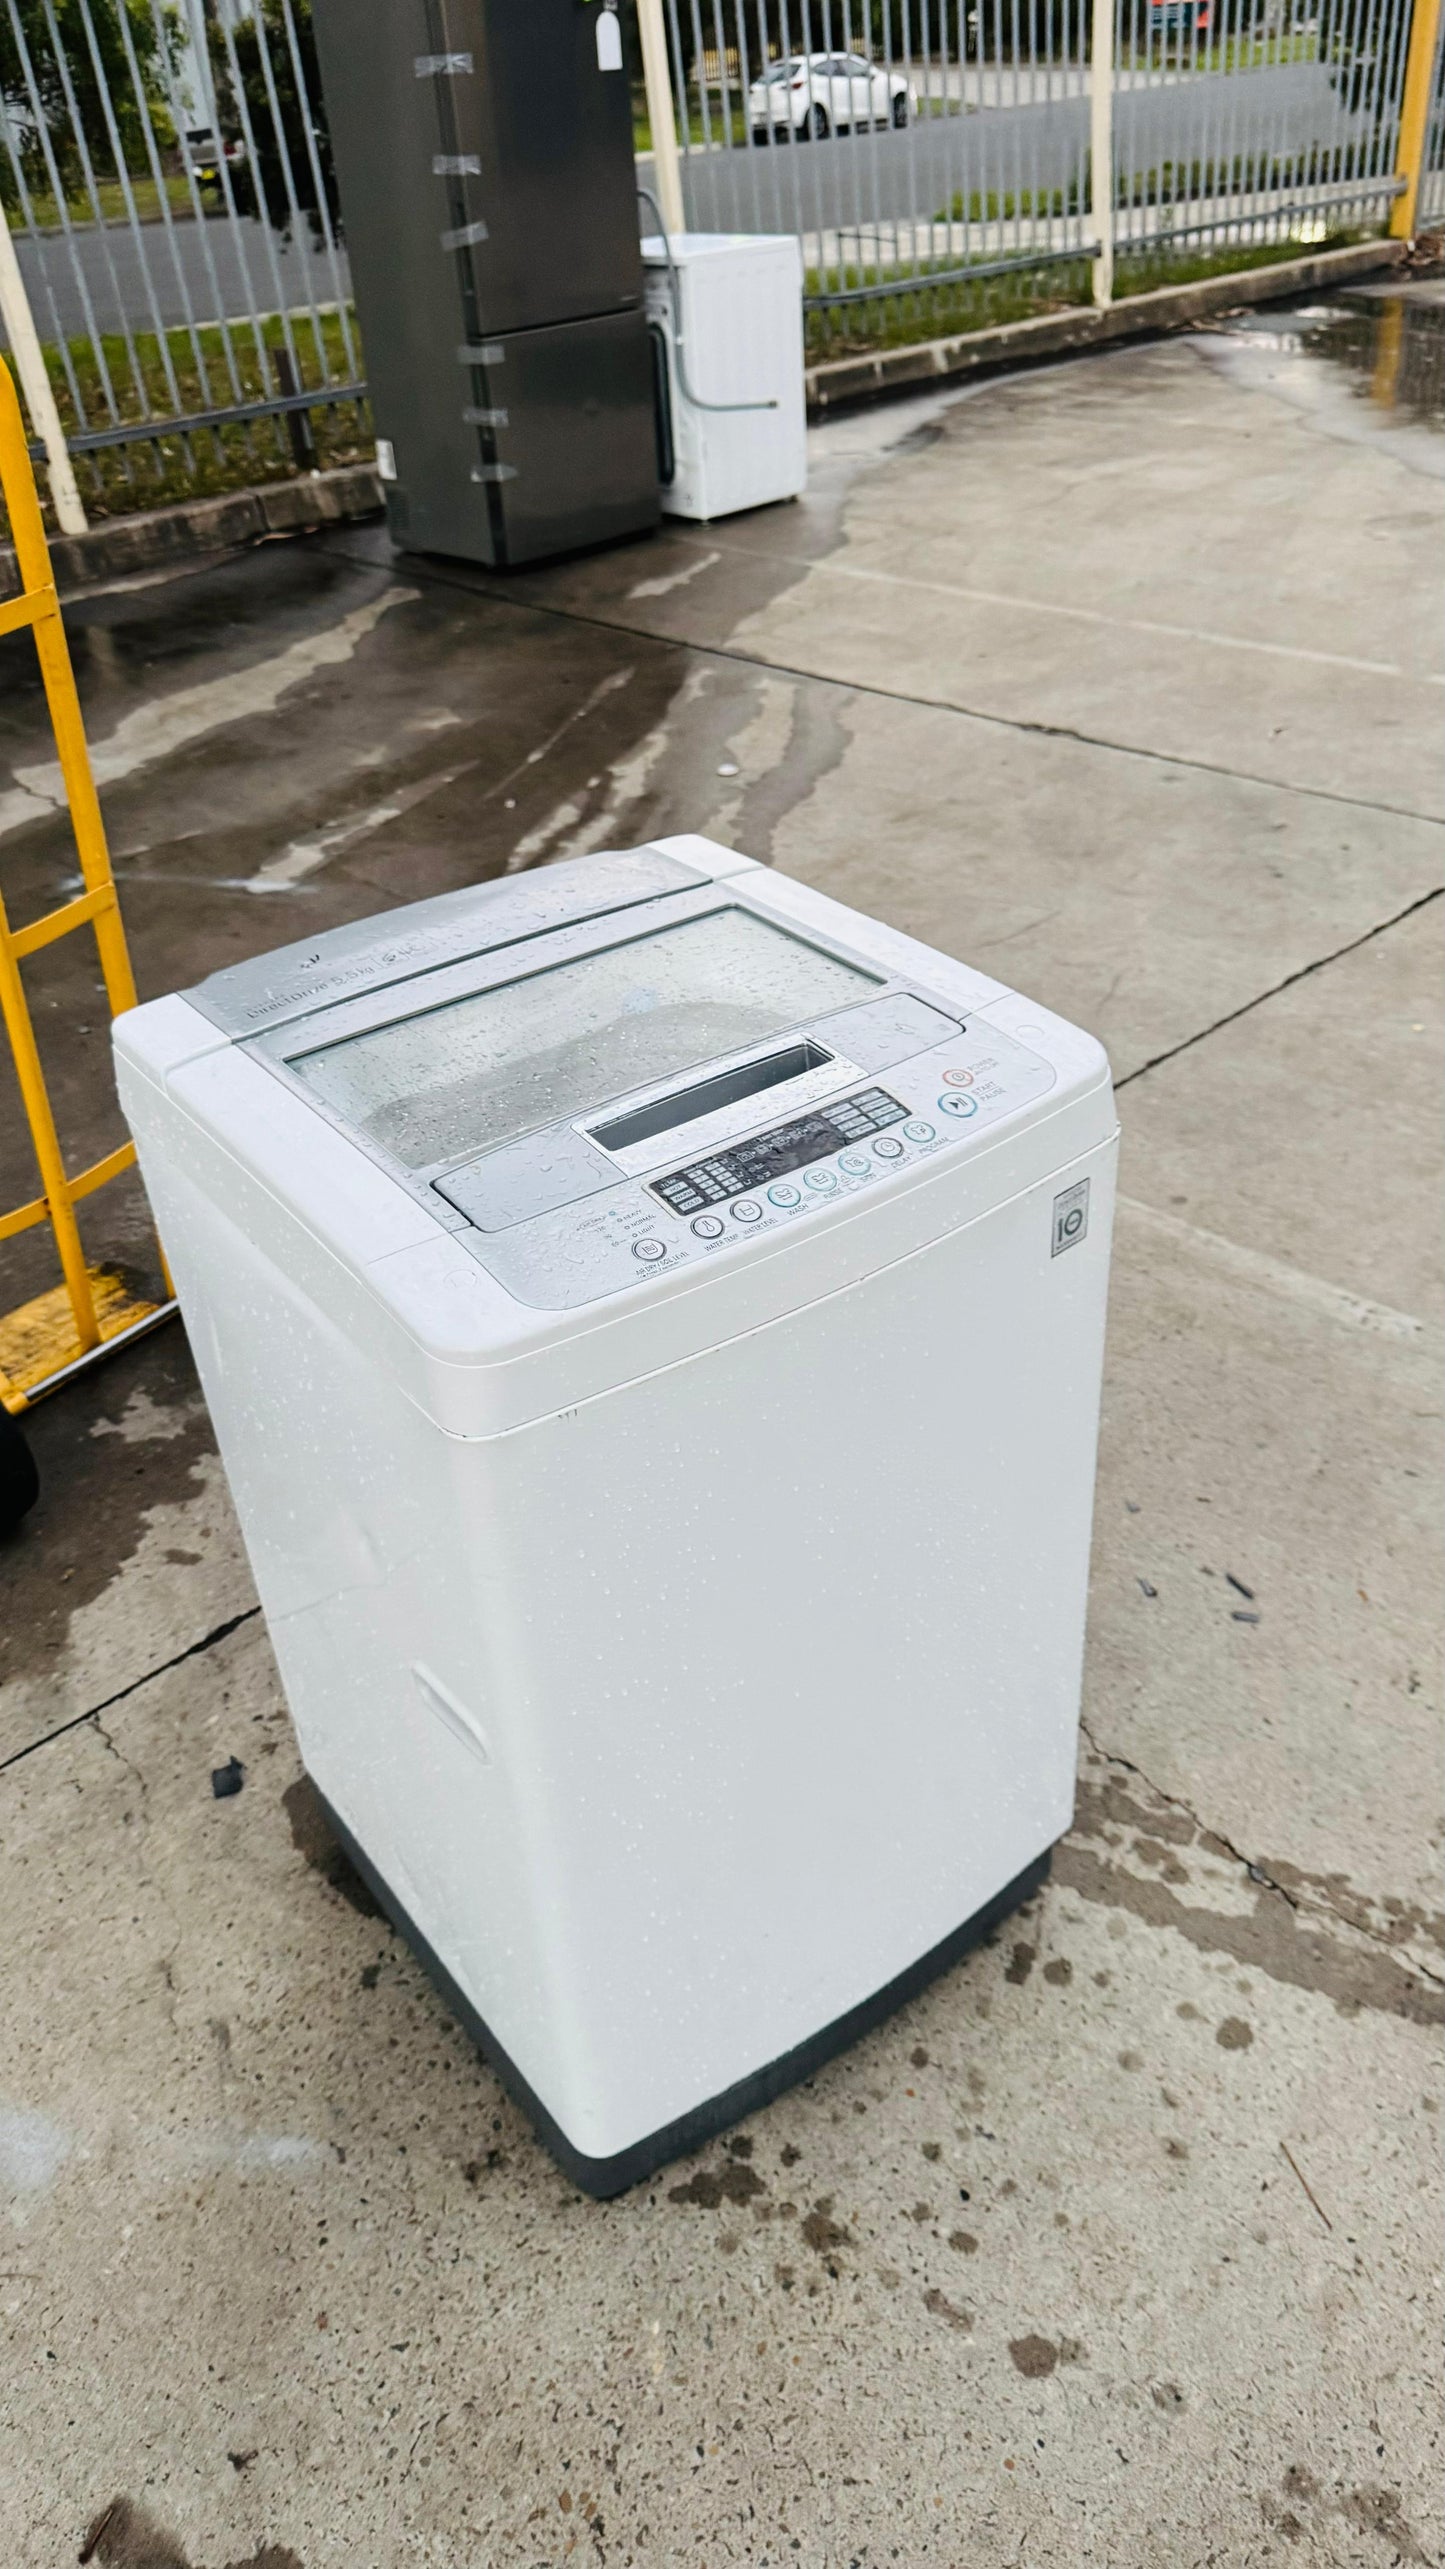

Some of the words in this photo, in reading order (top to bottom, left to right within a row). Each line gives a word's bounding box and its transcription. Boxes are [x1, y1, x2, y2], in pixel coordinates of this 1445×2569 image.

[971, 1080, 997, 1096] START
[890, 1151, 913, 1169] DELAY
[683, 1198, 701, 1209] COLD
[786, 1203, 810, 1217] WASH
[631, 1214, 657, 1227] NORMAL
[743, 1222, 762, 1236] WATER
[760, 1216, 779, 1230] LEVEL
[638, 1223, 656, 1235] LIGHT
[703, 1240, 724, 1253] WATER
[645, 1263, 656, 1273] DRY
[672, 1250, 690, 1262] LEVEL
